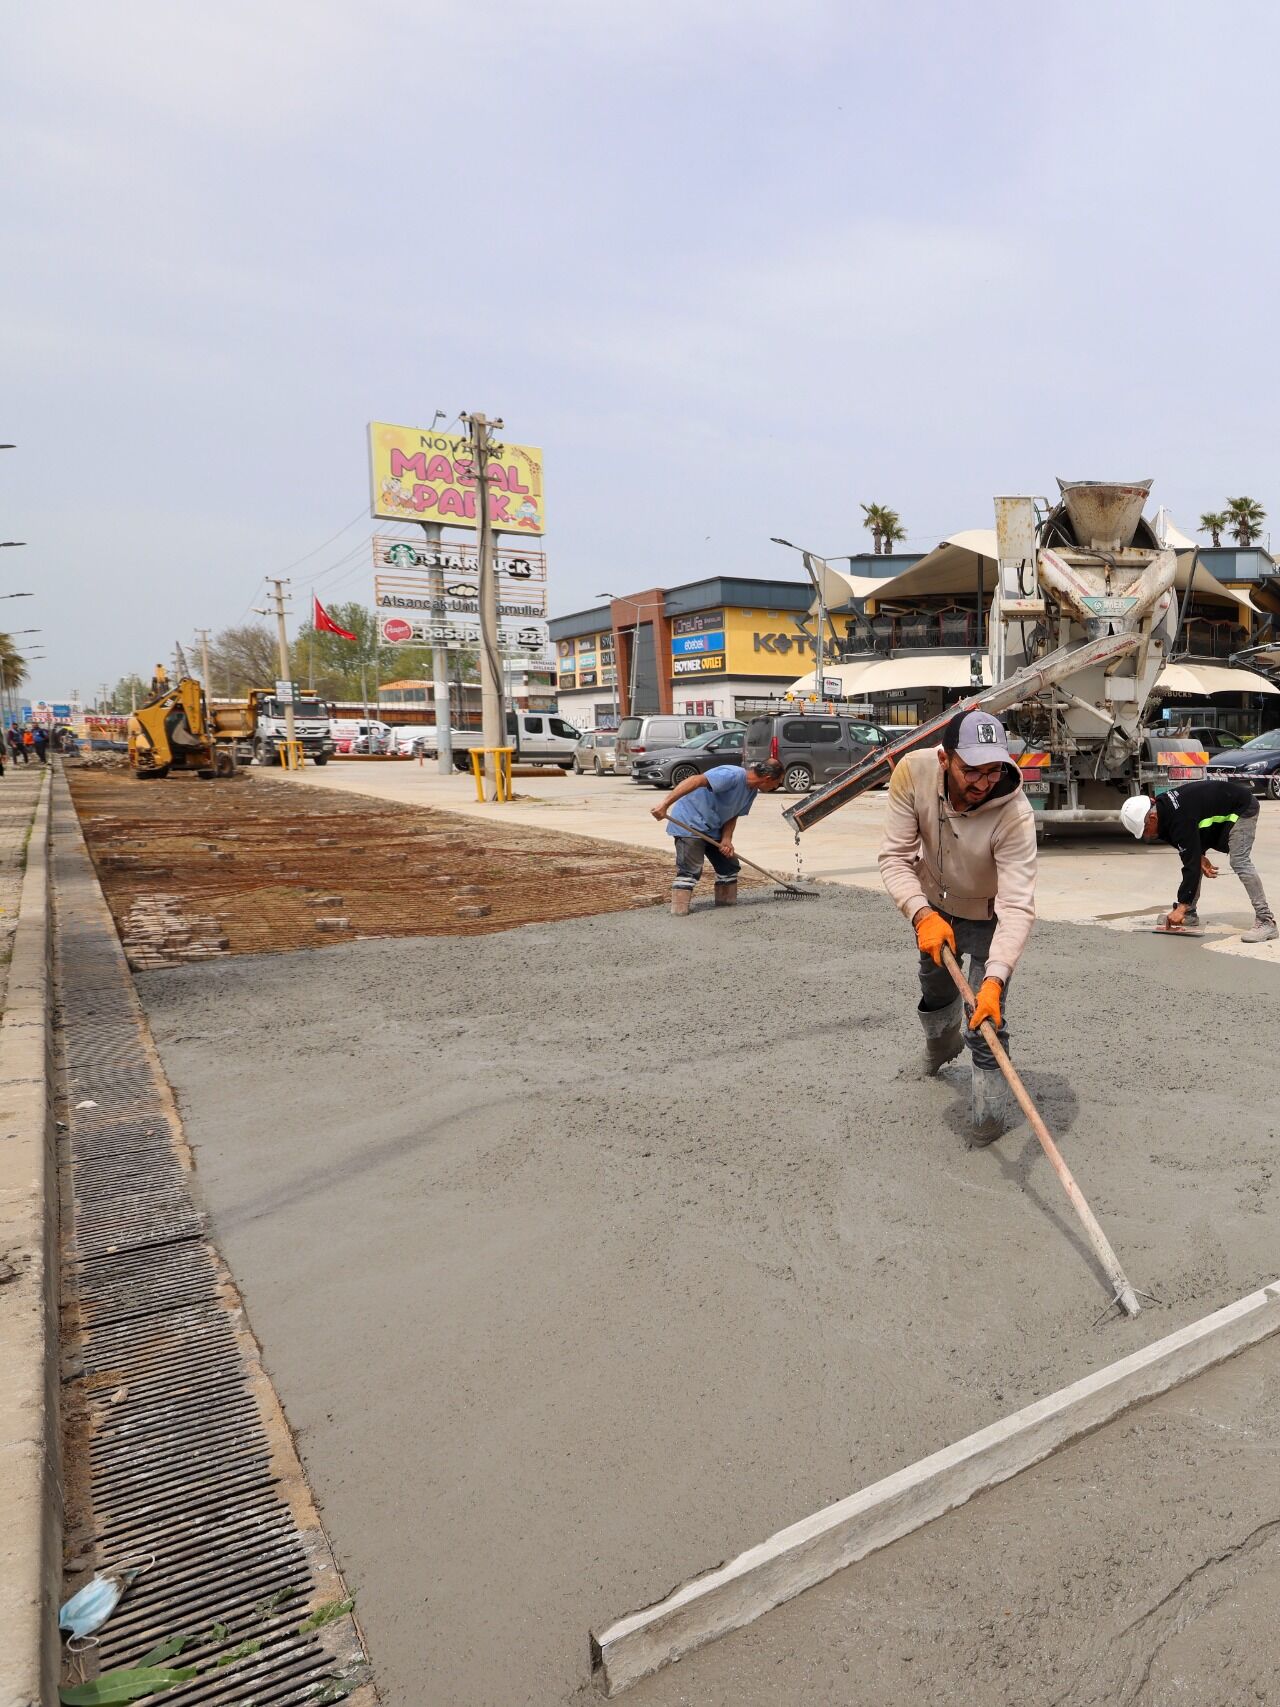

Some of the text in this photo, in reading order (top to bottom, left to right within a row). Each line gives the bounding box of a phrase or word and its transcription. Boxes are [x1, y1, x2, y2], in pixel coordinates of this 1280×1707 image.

[391, 448, 529, 494] MASAL
[424, 552, 539, 574] STARUCKS
[684, 638, 705, 650] ebebek
[674, 656, 722, 672] BOYNER OUTLET
